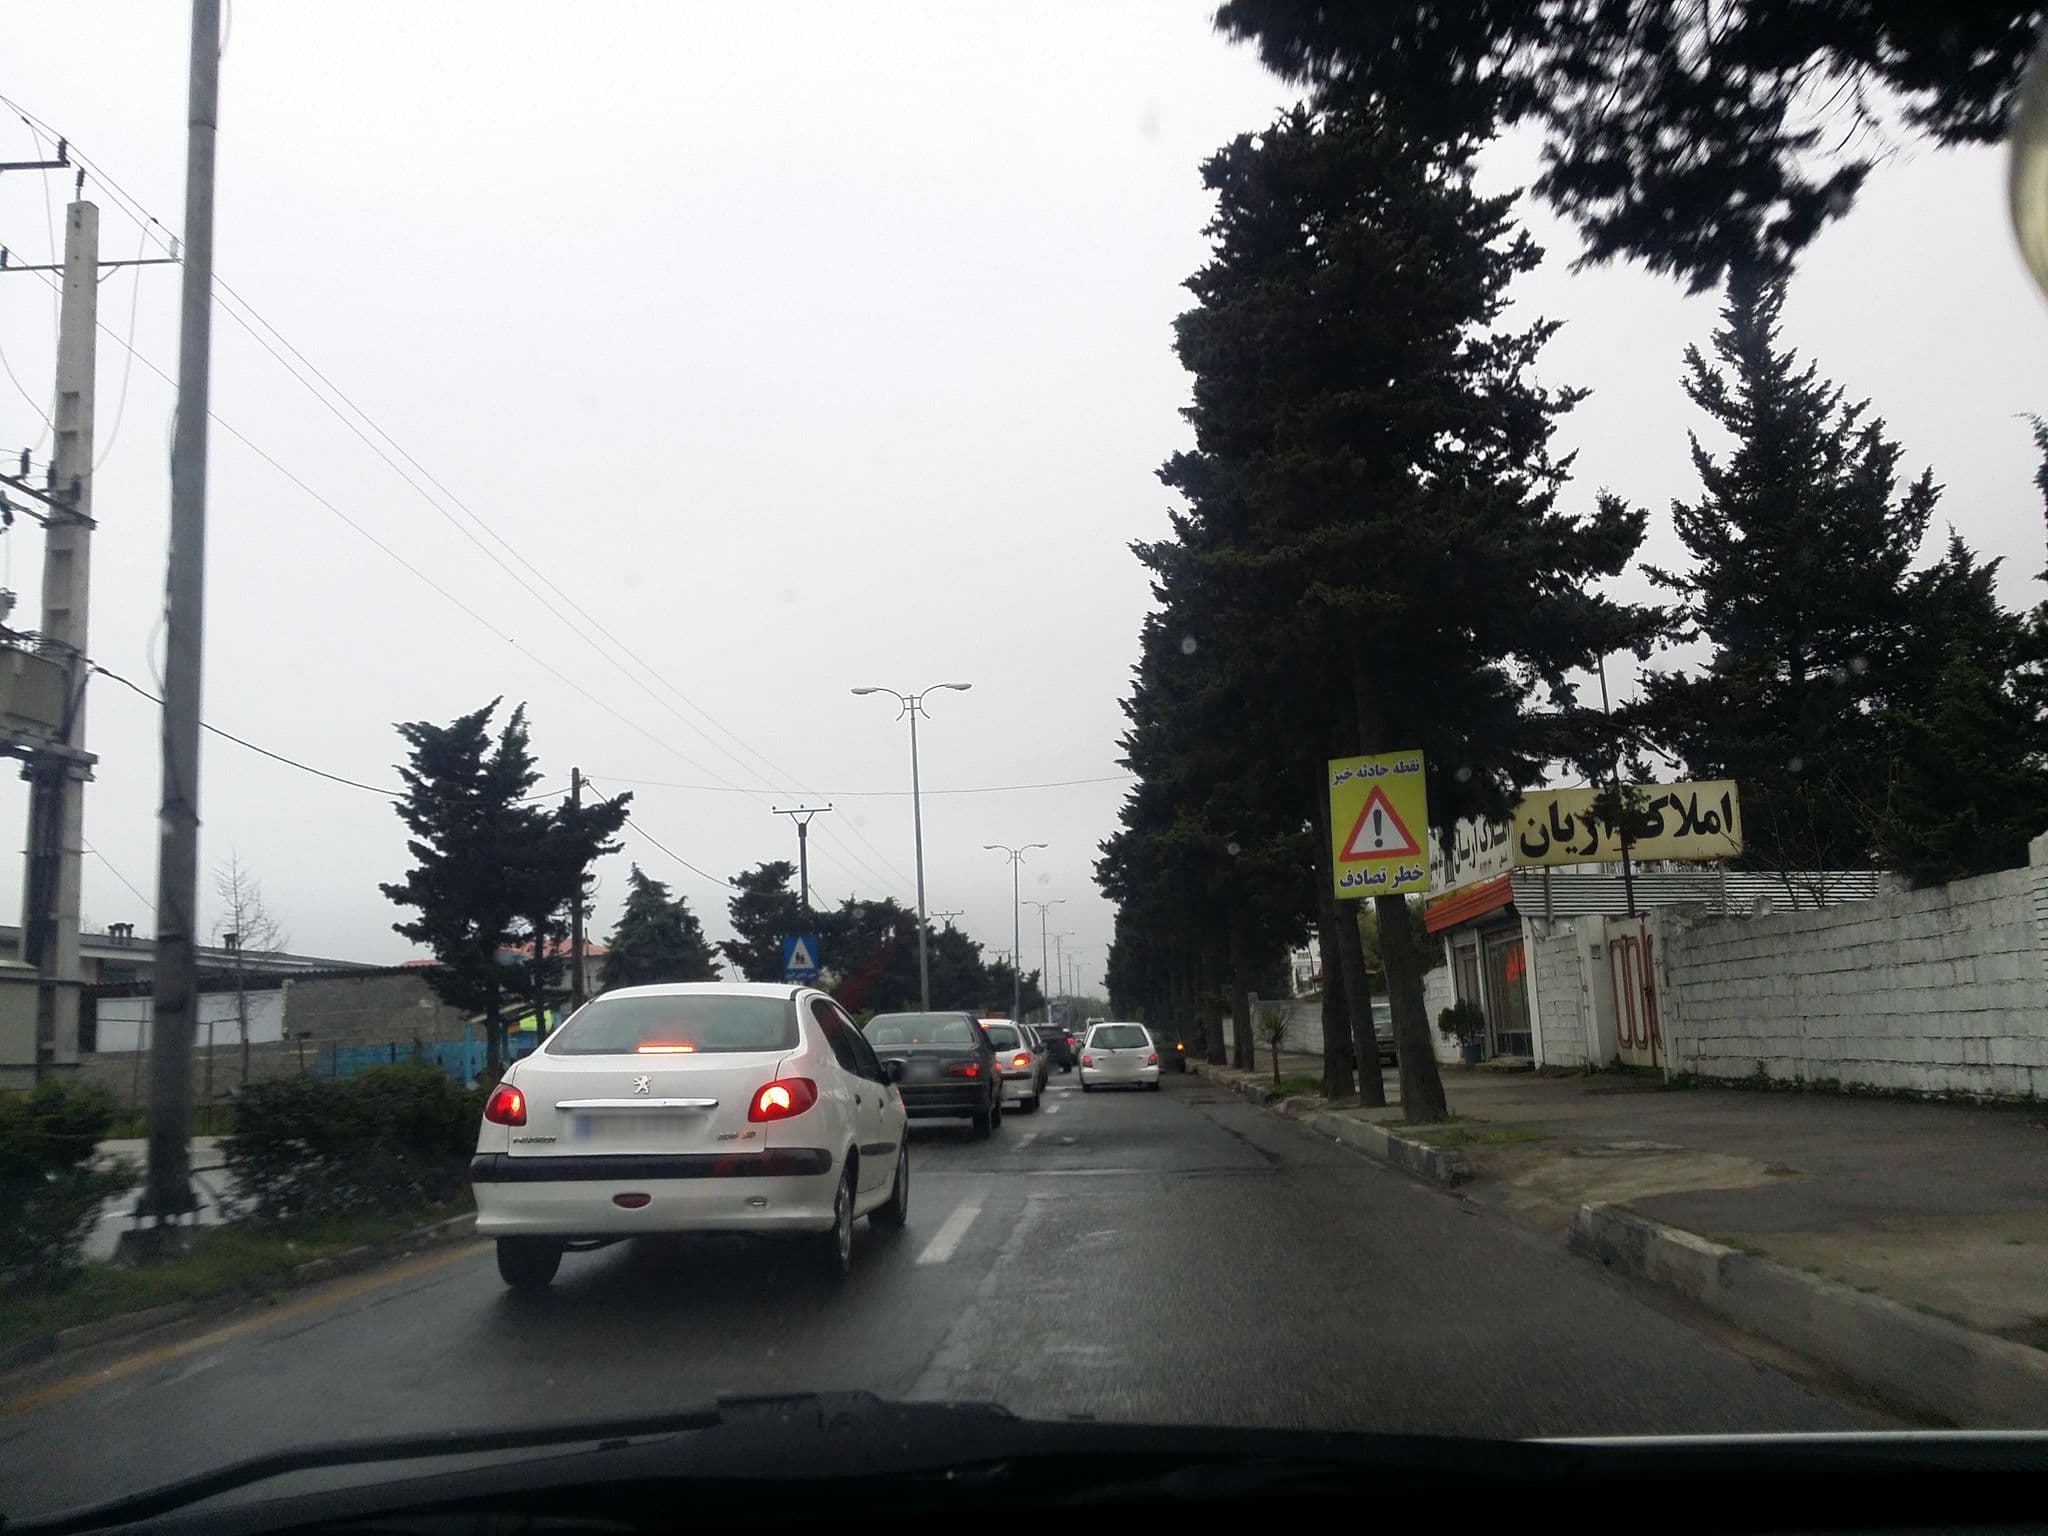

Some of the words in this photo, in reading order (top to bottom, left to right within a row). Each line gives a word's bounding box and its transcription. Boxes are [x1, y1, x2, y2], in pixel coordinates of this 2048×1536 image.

[1356, 763, 1389, 778] حادثه
[1392, 759, 1420, 774] نقطه
[1332, 767, 1353, 786] خیز
[1339, 867, 1387, 888] تصادف
[1391, 864, 1424, 889] خطر
